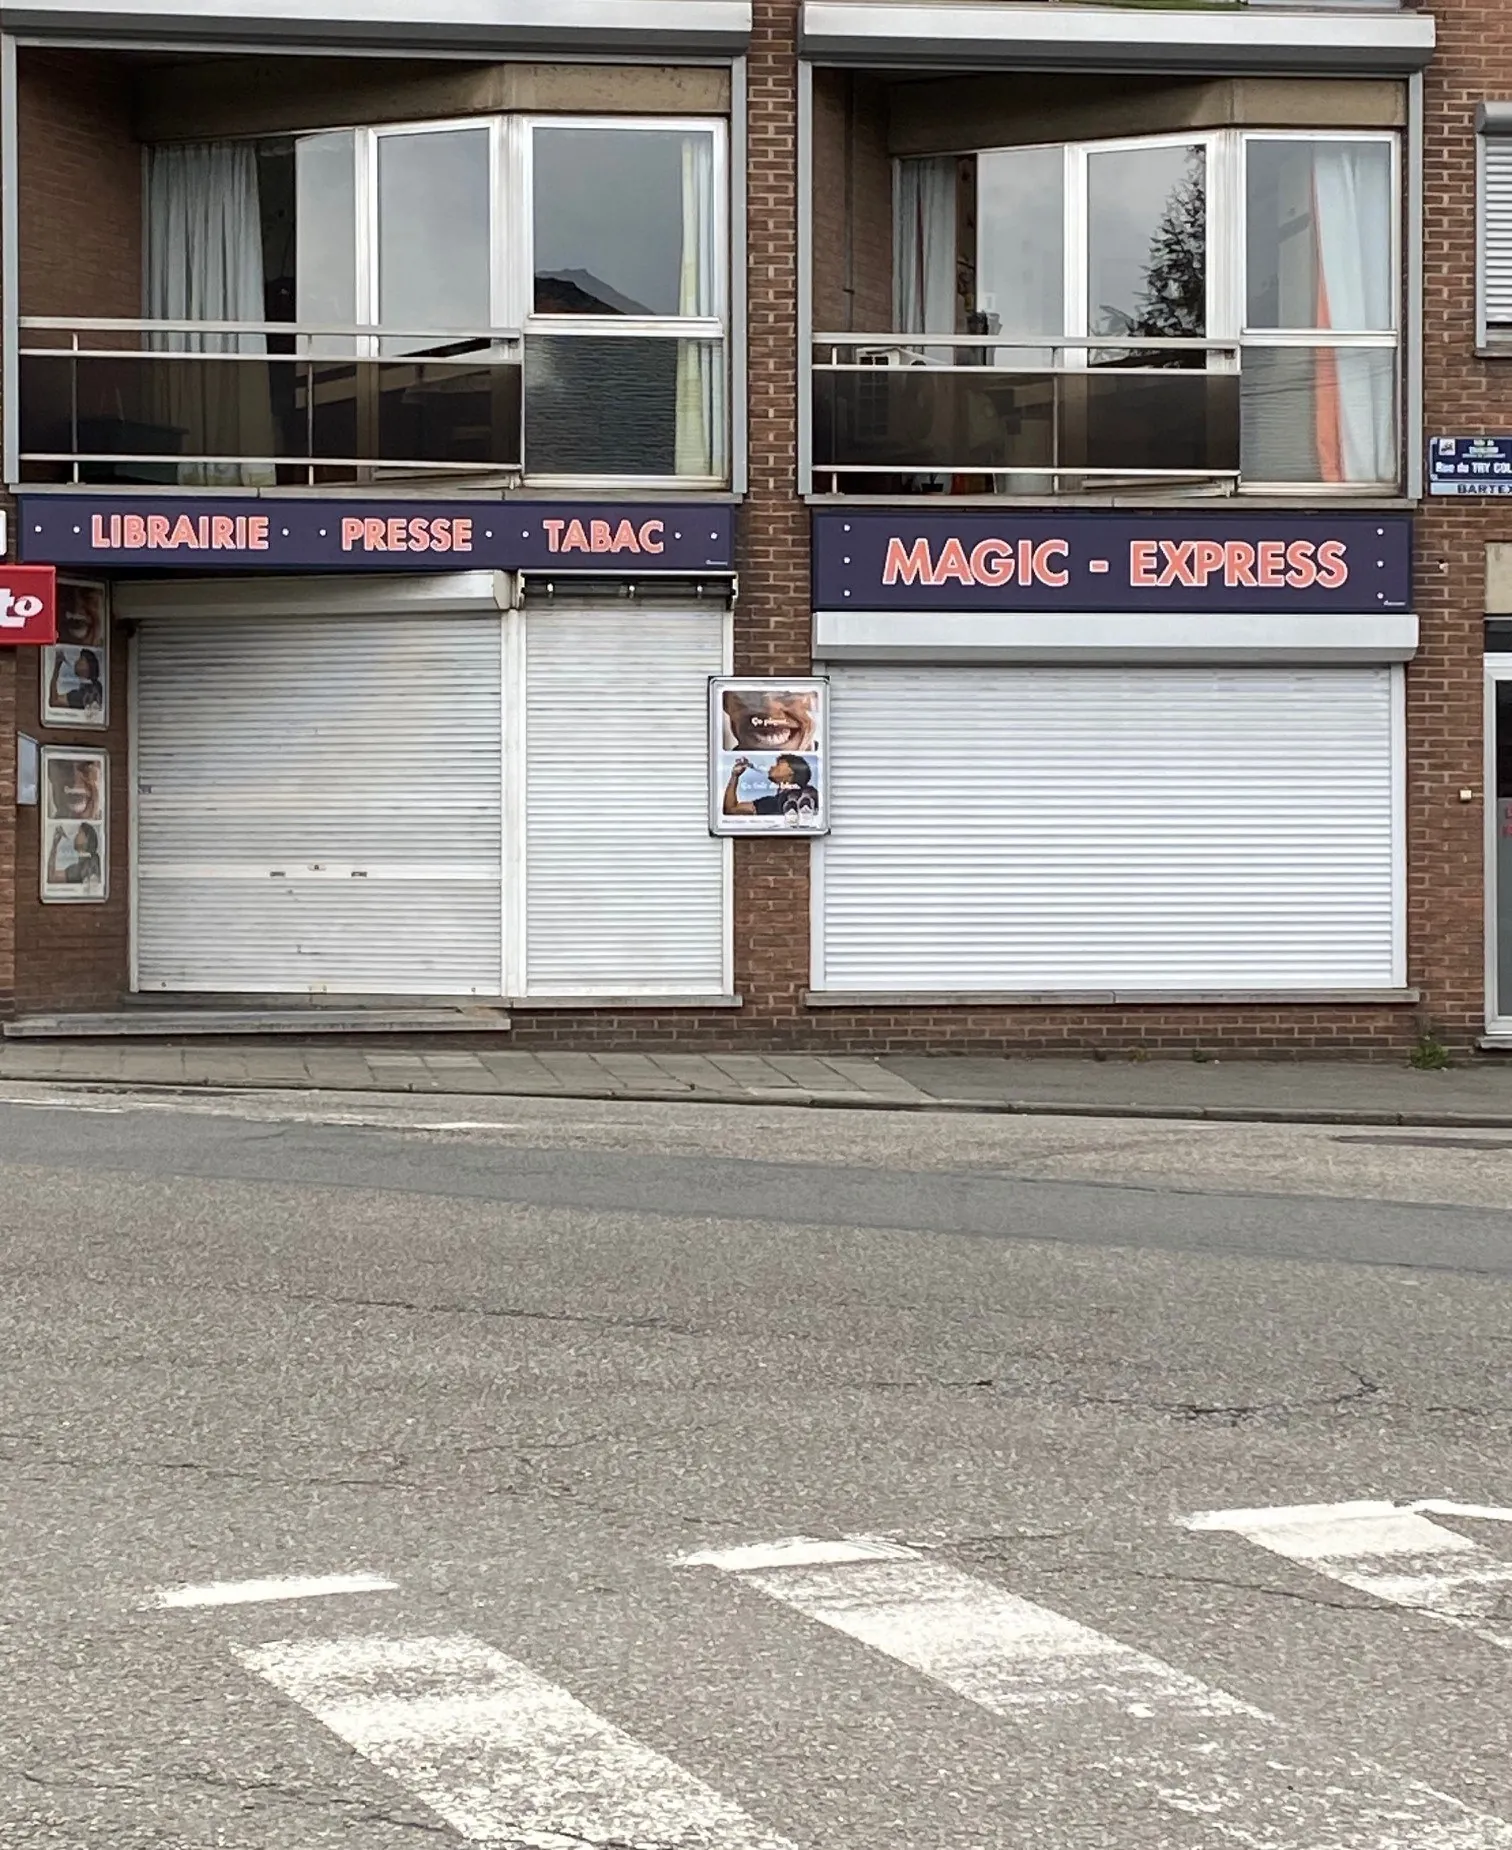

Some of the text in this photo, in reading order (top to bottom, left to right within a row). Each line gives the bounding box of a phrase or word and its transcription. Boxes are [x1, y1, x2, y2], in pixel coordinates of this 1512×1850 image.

[91, 514, 664, 554] LIBRAIRIE PRESSE TABAC
[882, 537, 1349, 589] MAGIC - EXPRESS
